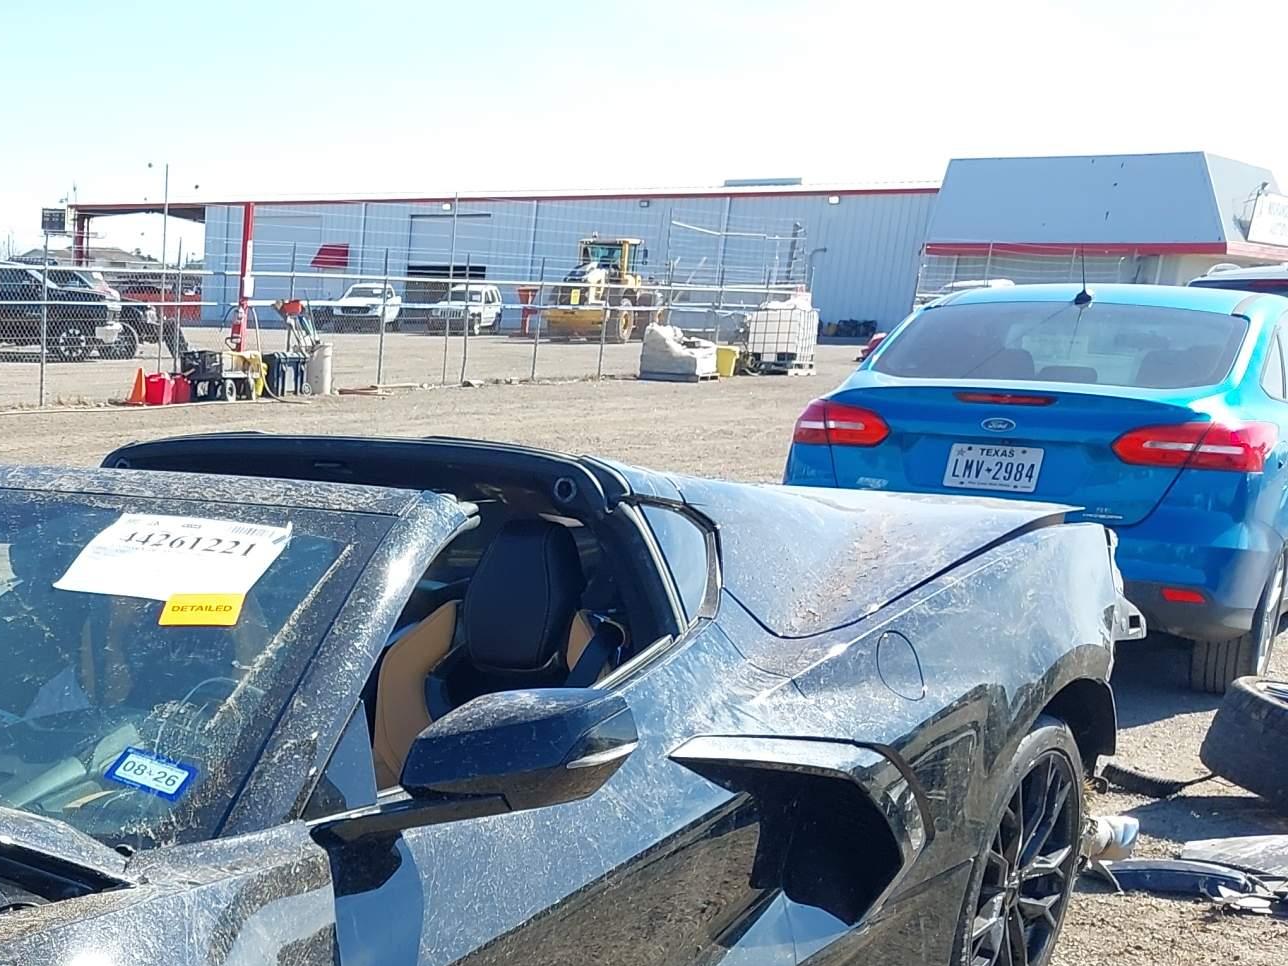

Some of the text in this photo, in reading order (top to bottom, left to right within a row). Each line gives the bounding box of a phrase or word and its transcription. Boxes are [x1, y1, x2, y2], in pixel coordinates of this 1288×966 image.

[979, 448, 1015, 458] TEXAS
[120, 531, 256, 557] 44261221
[171, 604, 232, 613] DETAILED
